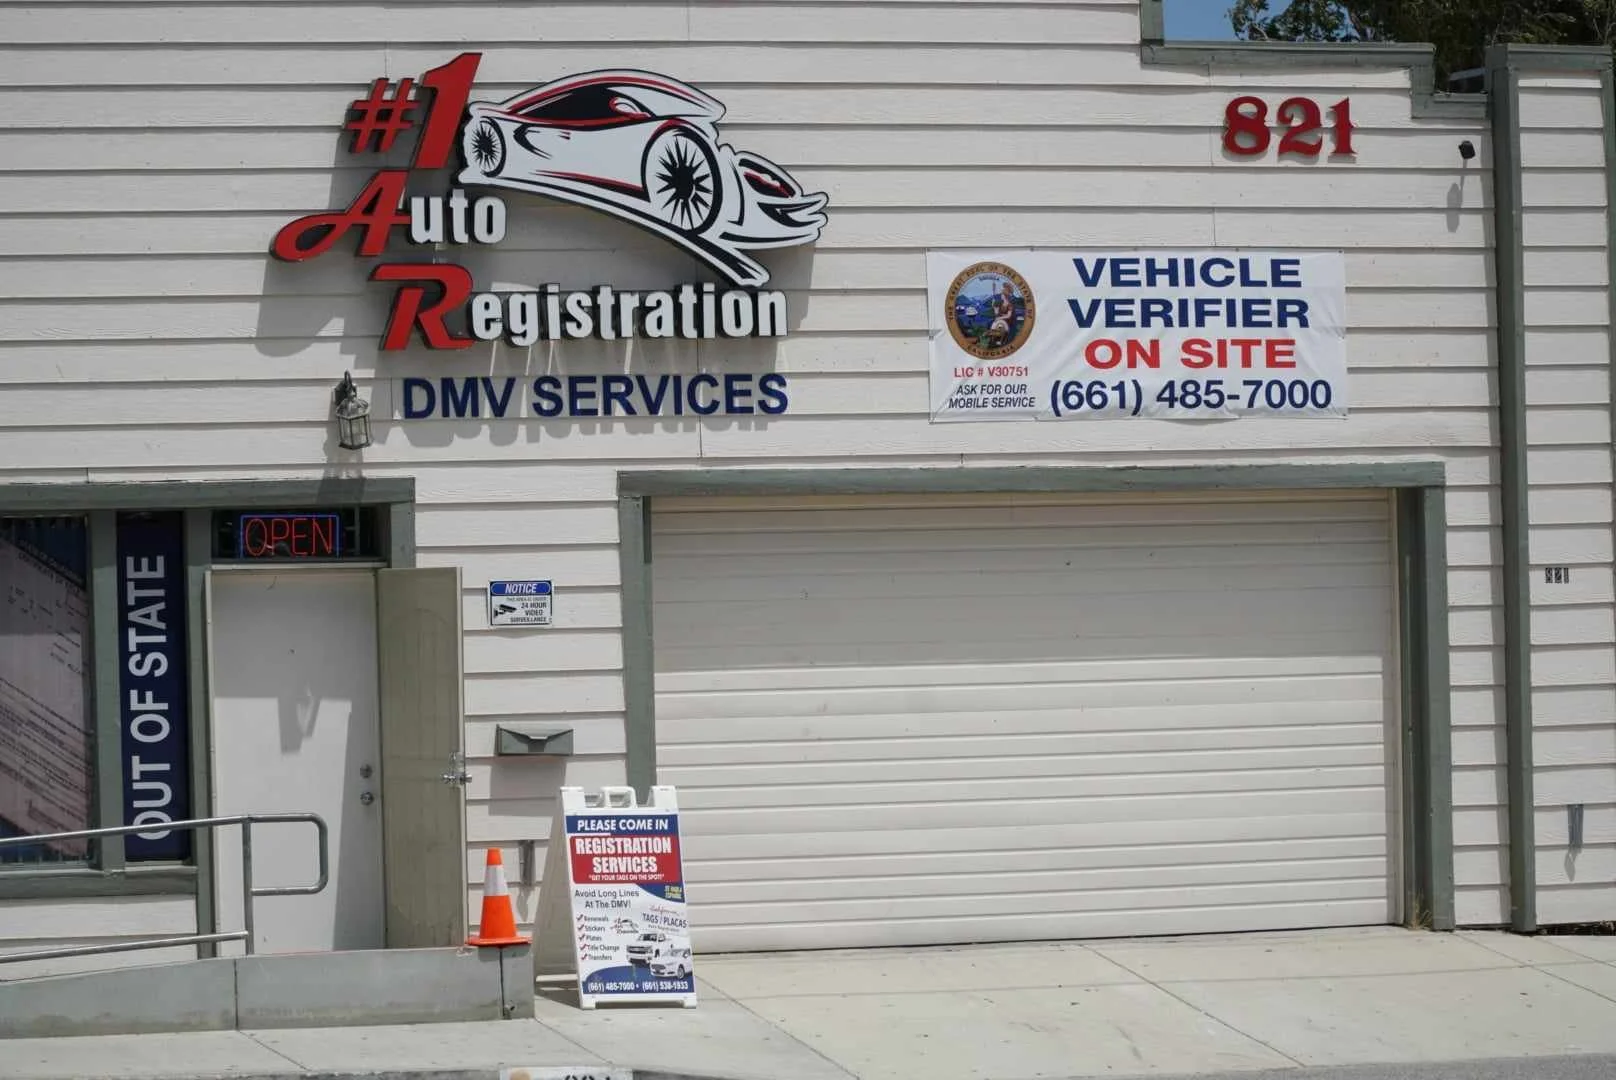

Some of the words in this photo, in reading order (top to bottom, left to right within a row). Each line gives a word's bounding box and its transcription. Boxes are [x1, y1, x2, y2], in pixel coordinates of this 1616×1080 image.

[345, 52, 482, 169] #1
[1223, 96, 1357, 156] 821
[271, 170, 507, 262] Auto
[1072, 257, 1302, 288] VEHICLE
[368, 263, 788, 351] Registration
[1066, 298, 1309, 329] VERIFIER
[1084, 338, 1160, 370] ON
[1181, 338, 1297, 369] SITE
[954, 367, 974, 378] LIC
[977, 368, 984, 377] #
[987, 366, 1029, 377] V30751
[403, 376, 517, 420] DMV
[532, 373, 789, 418] SERVICES
[948, 397, 989, 409] MOBILE
[991, 397, 1036, 408] SERVICE
[956, 384, 978, 395] ASK
[980, 384, 1002, 395] FOR
[1004, 383, 1027, 394] OUR
[1050, 379, 1142, 417] (661)
[1156, 380, 1331, 409] 485-7000
[245, 517, 333, 556] OPEN
[505, 583, 537, 594] NOTICE
[126, 555, 168, 677] STATE
[130, 690, 170, 743] OF
[132, 755, 172, 840] OUT
[577, 820, 616, 831] PLEASE
[619, 819, 652, 831] COME
[655, 818, 669, 830] IN
[575, 837, 672, 854] REGISTRATION
[592, 856, 658, 873] SERVICES
[575, 889, 596, 897] Avoid
[598, 890, 617, 899] Long
[619, 889, 640, 897] Lines
[595, 900, 609, 908] The
[642, 912, 658, 924] TAGS
[663, 916, 688, 928] PLACAS
